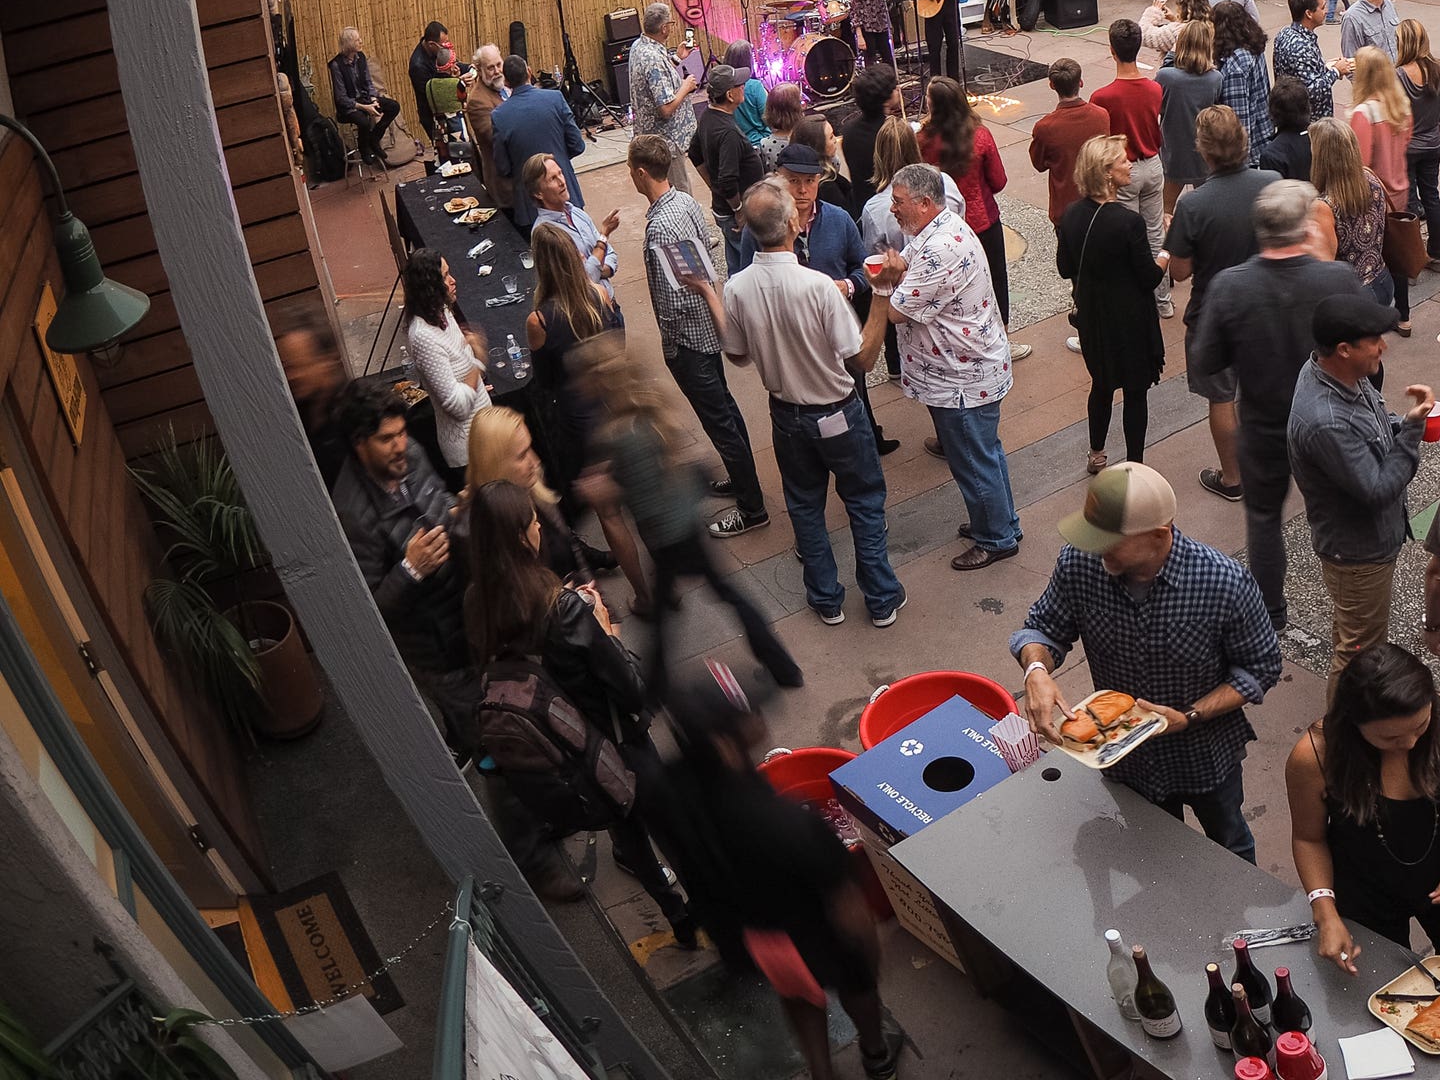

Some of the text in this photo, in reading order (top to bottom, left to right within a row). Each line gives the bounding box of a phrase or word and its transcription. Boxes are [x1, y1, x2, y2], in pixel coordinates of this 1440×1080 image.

[961, 727, 984, 745] ONLY
[876, 781, 934, 824] RECYCLE ONLY
